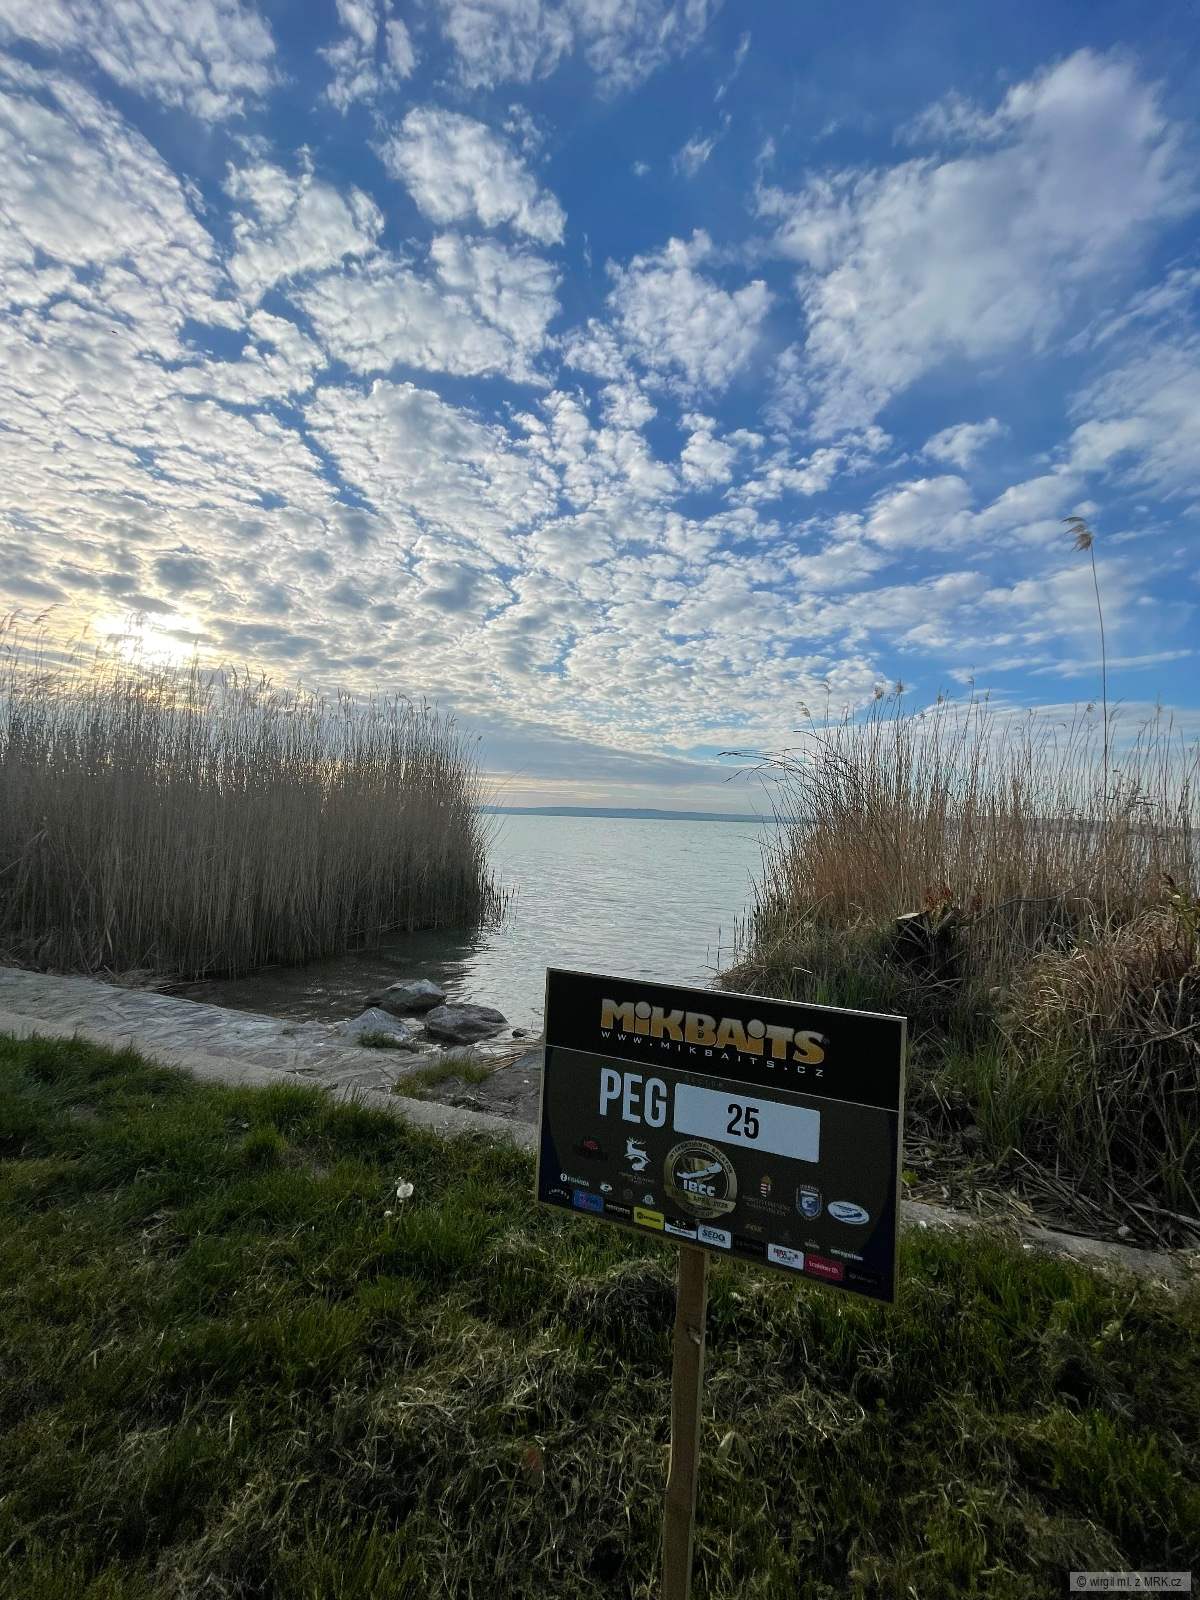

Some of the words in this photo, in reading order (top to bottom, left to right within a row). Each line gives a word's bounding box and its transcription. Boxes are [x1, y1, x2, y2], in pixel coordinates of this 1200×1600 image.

[600, 1031, 824, 1077] WWW.MIKBAITS.CZ
[599, 1067, 667, 1128] PEG
[727, 1103, 759, 1139] 25
